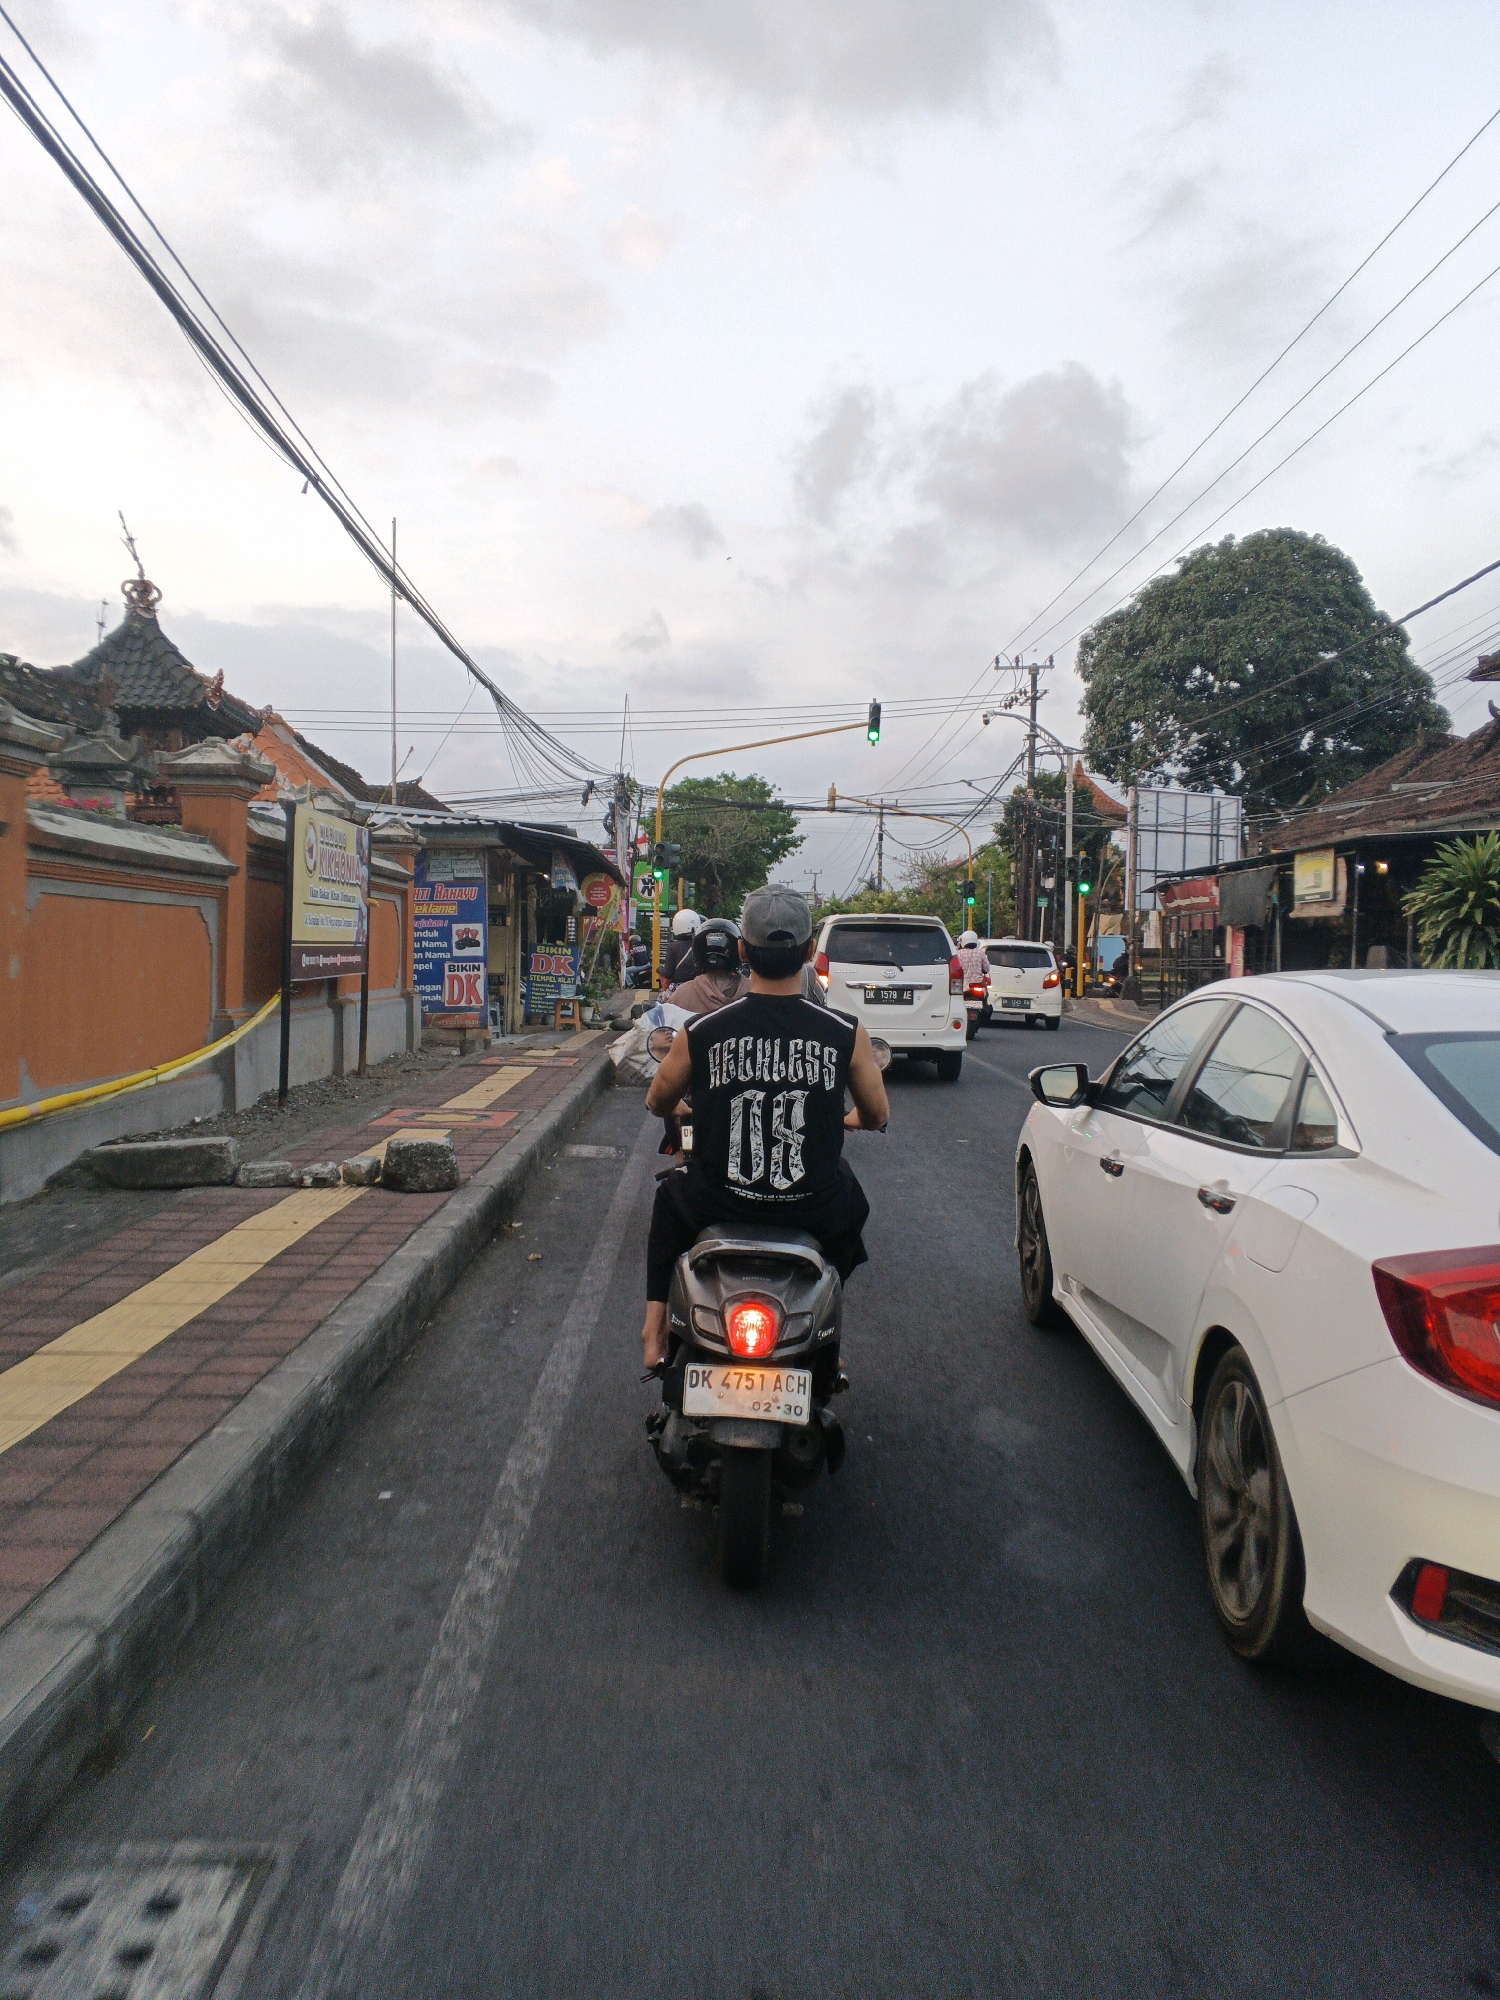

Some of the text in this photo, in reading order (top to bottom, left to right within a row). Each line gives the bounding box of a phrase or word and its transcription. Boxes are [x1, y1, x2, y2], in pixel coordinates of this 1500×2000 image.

[434, 883, 478, 901] RAHAYU
[414, 904, 456, 914] eklame
[421, 940, 448, 948] Nama
[536, 945, 572, 955] BIKIN
[447, 964, 481, 972] BIKIN
[530, 953, 576, 976] DK
[529, 974, 557, 983] STEMPEL
[446, 973, 483, 1005] DK
[865, 989, 912, 1000] DK 1579 AE
[688, 1369, 807, 1396] DK 4751 ACH
